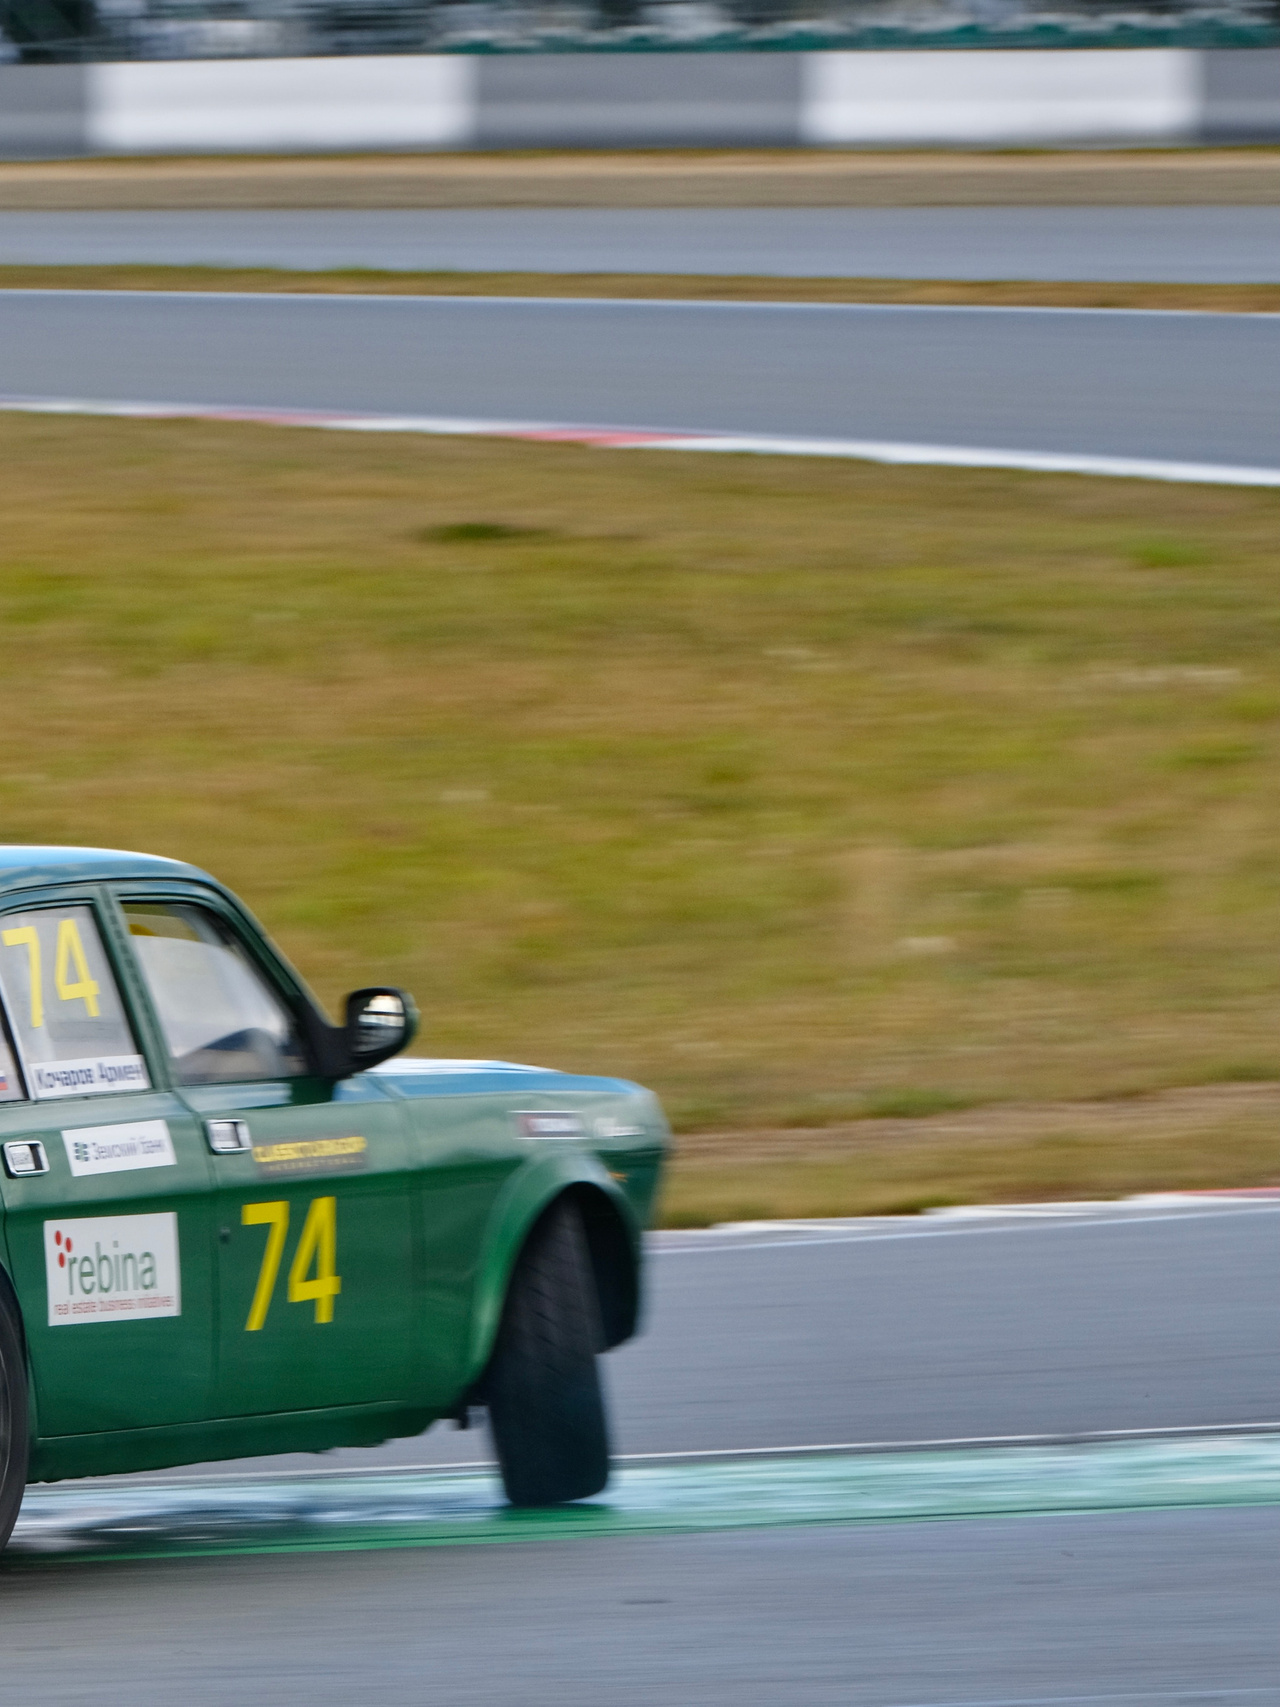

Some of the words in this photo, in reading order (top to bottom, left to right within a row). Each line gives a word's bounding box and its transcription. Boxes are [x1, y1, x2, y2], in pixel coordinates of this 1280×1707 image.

[1, 918, 101, 1028] 74
[67, 1240, 158, 1296] rebina
[241, 1196, 342, 1331] 74
